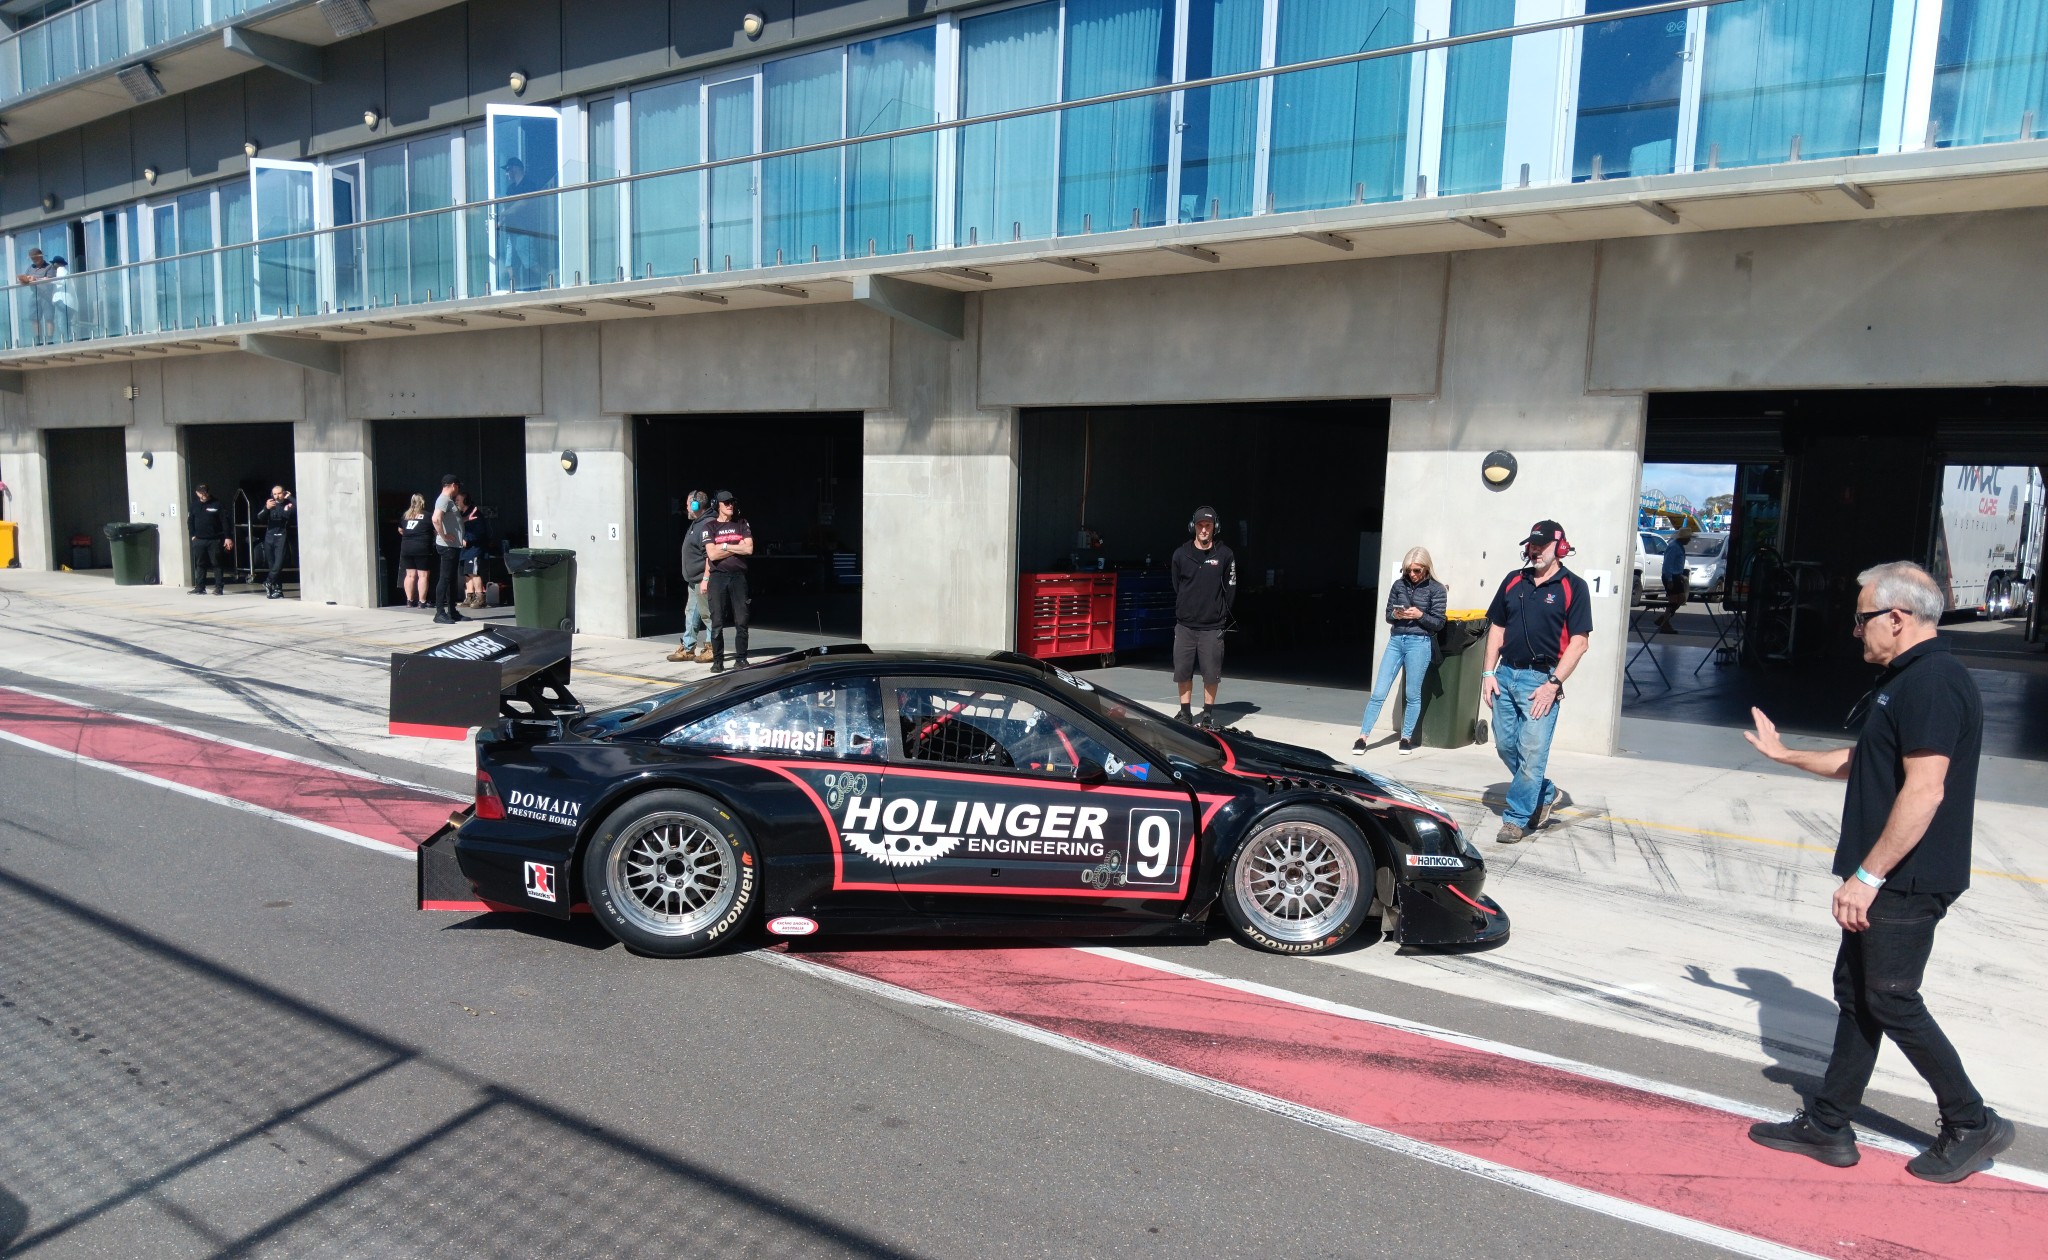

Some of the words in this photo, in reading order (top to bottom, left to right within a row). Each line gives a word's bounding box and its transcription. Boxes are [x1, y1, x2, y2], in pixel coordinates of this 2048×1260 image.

[611, 527, 616, 538] 3
[1593, 576, 1601, 593] 1
[428, 635, 507, 661] OLINGER
[723, 720, 743, 745] S.
[747, 722, 824, 751] Tamasi
[507, 806, 547, 821] PRESTIGE
[548, 814, 577, 827] HOMES
[509, 790, 581, 817] DOMAIN
[843, 796, 1109, 840] HOLINGER
[968, 837, 1105, 857] ENGINEERING
[1137, 815, 1171, 879] 9
